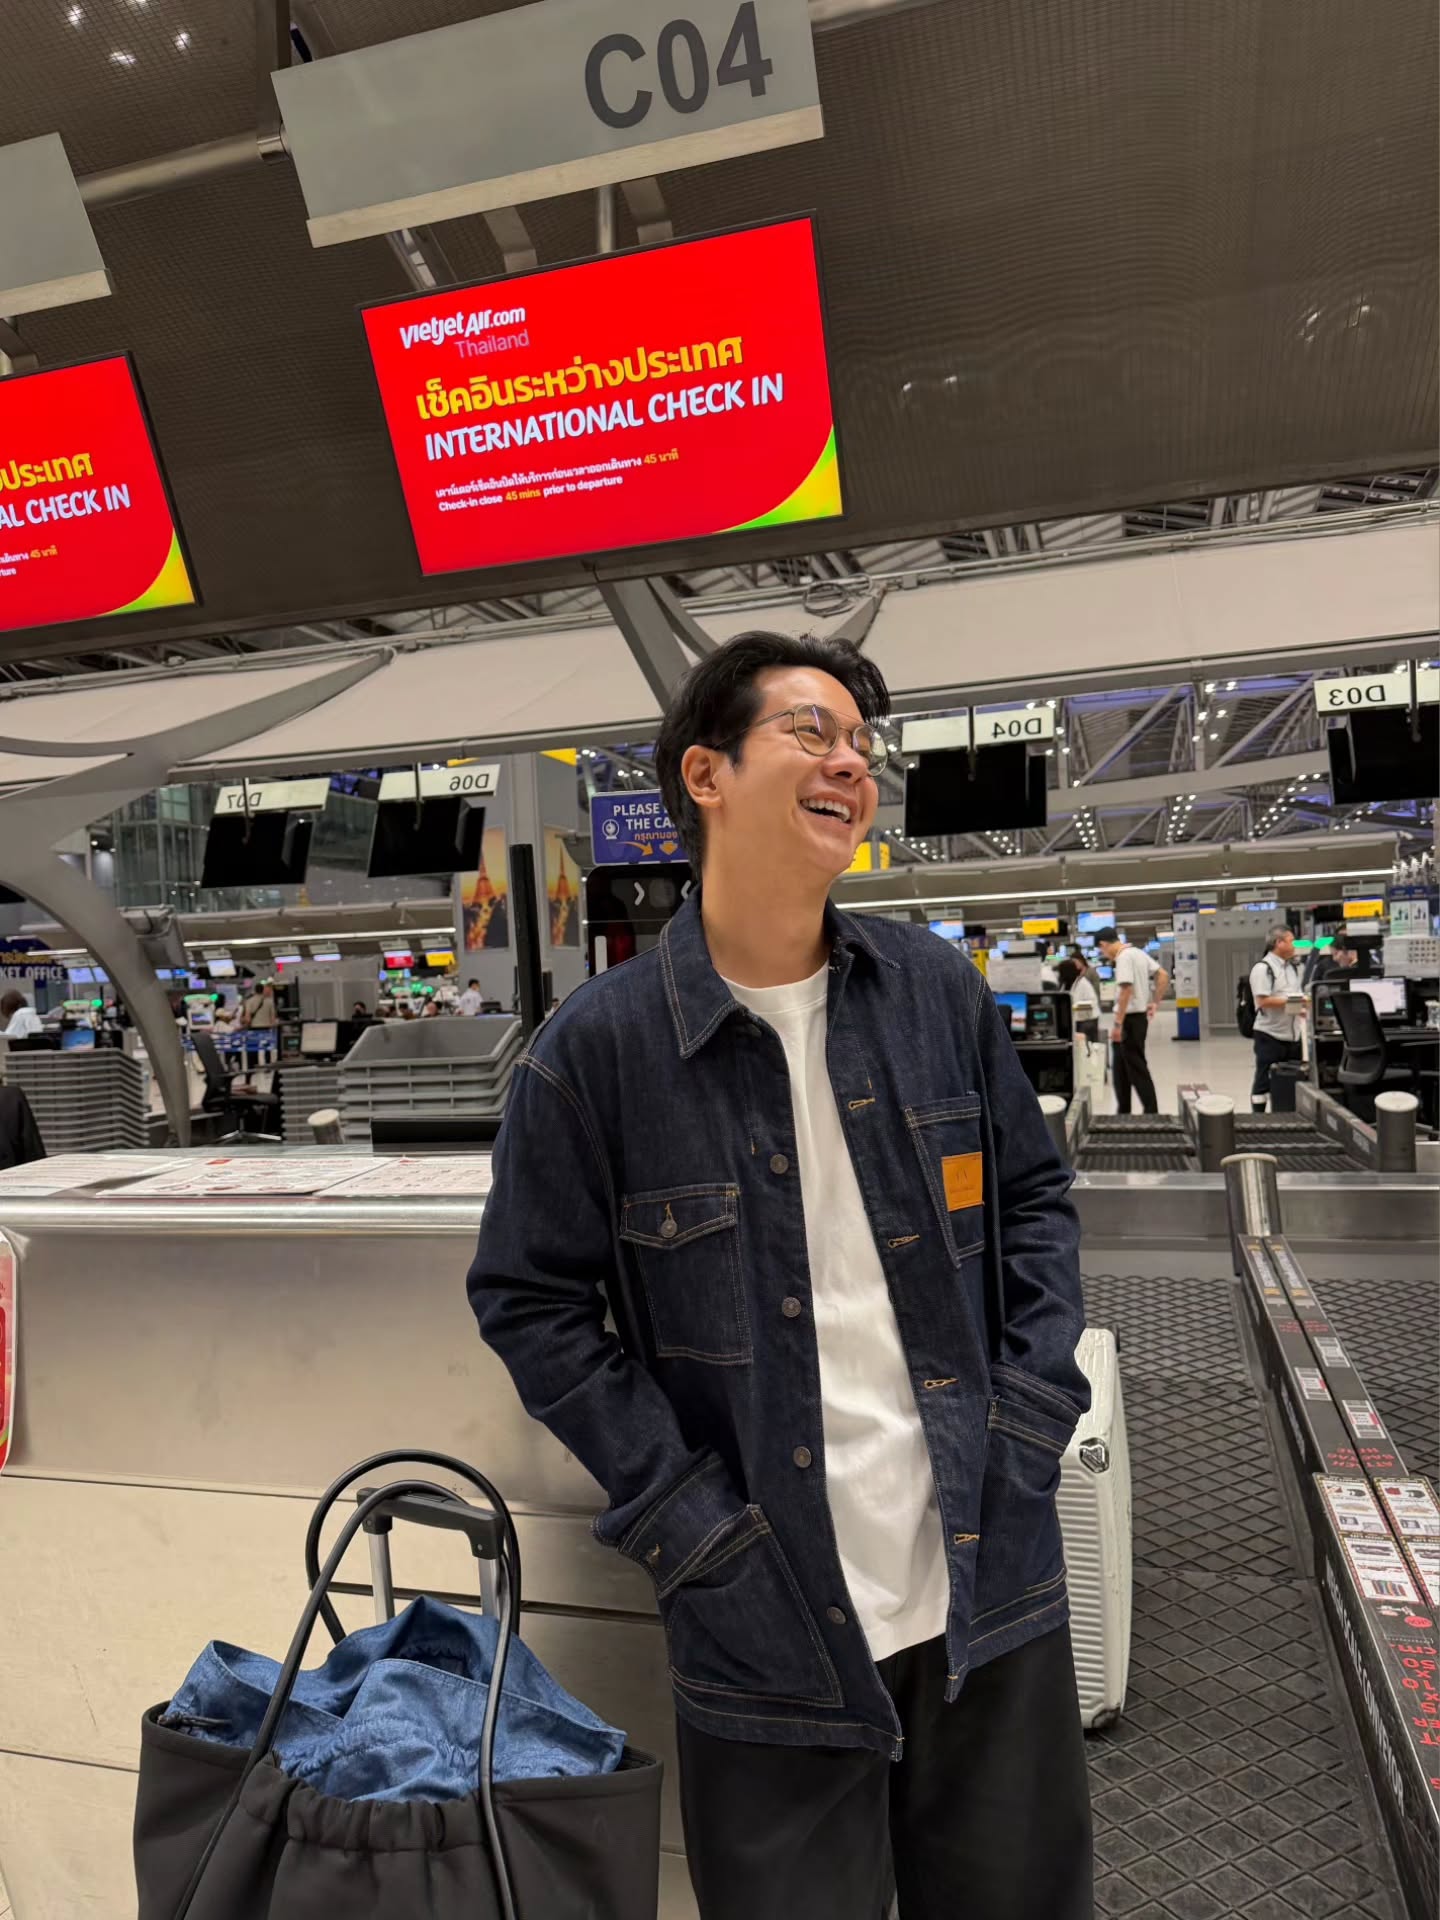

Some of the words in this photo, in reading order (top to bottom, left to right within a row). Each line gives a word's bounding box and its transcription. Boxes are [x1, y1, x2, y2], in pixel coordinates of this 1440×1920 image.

[585, 1, 773, 129] C04
[453, 328, 530, 358] Thailand
[416, 336, 744, 420] เช็คอินระหว่างประเทศ
[425, 398, 644, 461] INTERNATIONAL
[647, 379, 746, 423] CHECK
[751, 372, 785, 407] IN
[0, 453, 94, 492] ประเทศ
[644, 453, 658, 465] 45
[25, 487, 103, 525] CHECK
[103, 483, 131, 512] IN
[478, 494, 503, 507] close
[505, 490, 519, 502] 45
[519, 488, 541, 499] mins
[543, 485, 565, 498] prior
[565, 482, 577, 493] to
[576, 475, 623, 491] departure
[613, 802, 660, 817] PLEASE
[625, 817, 651, 831] THE
[654, 816, 676, 829] CA
